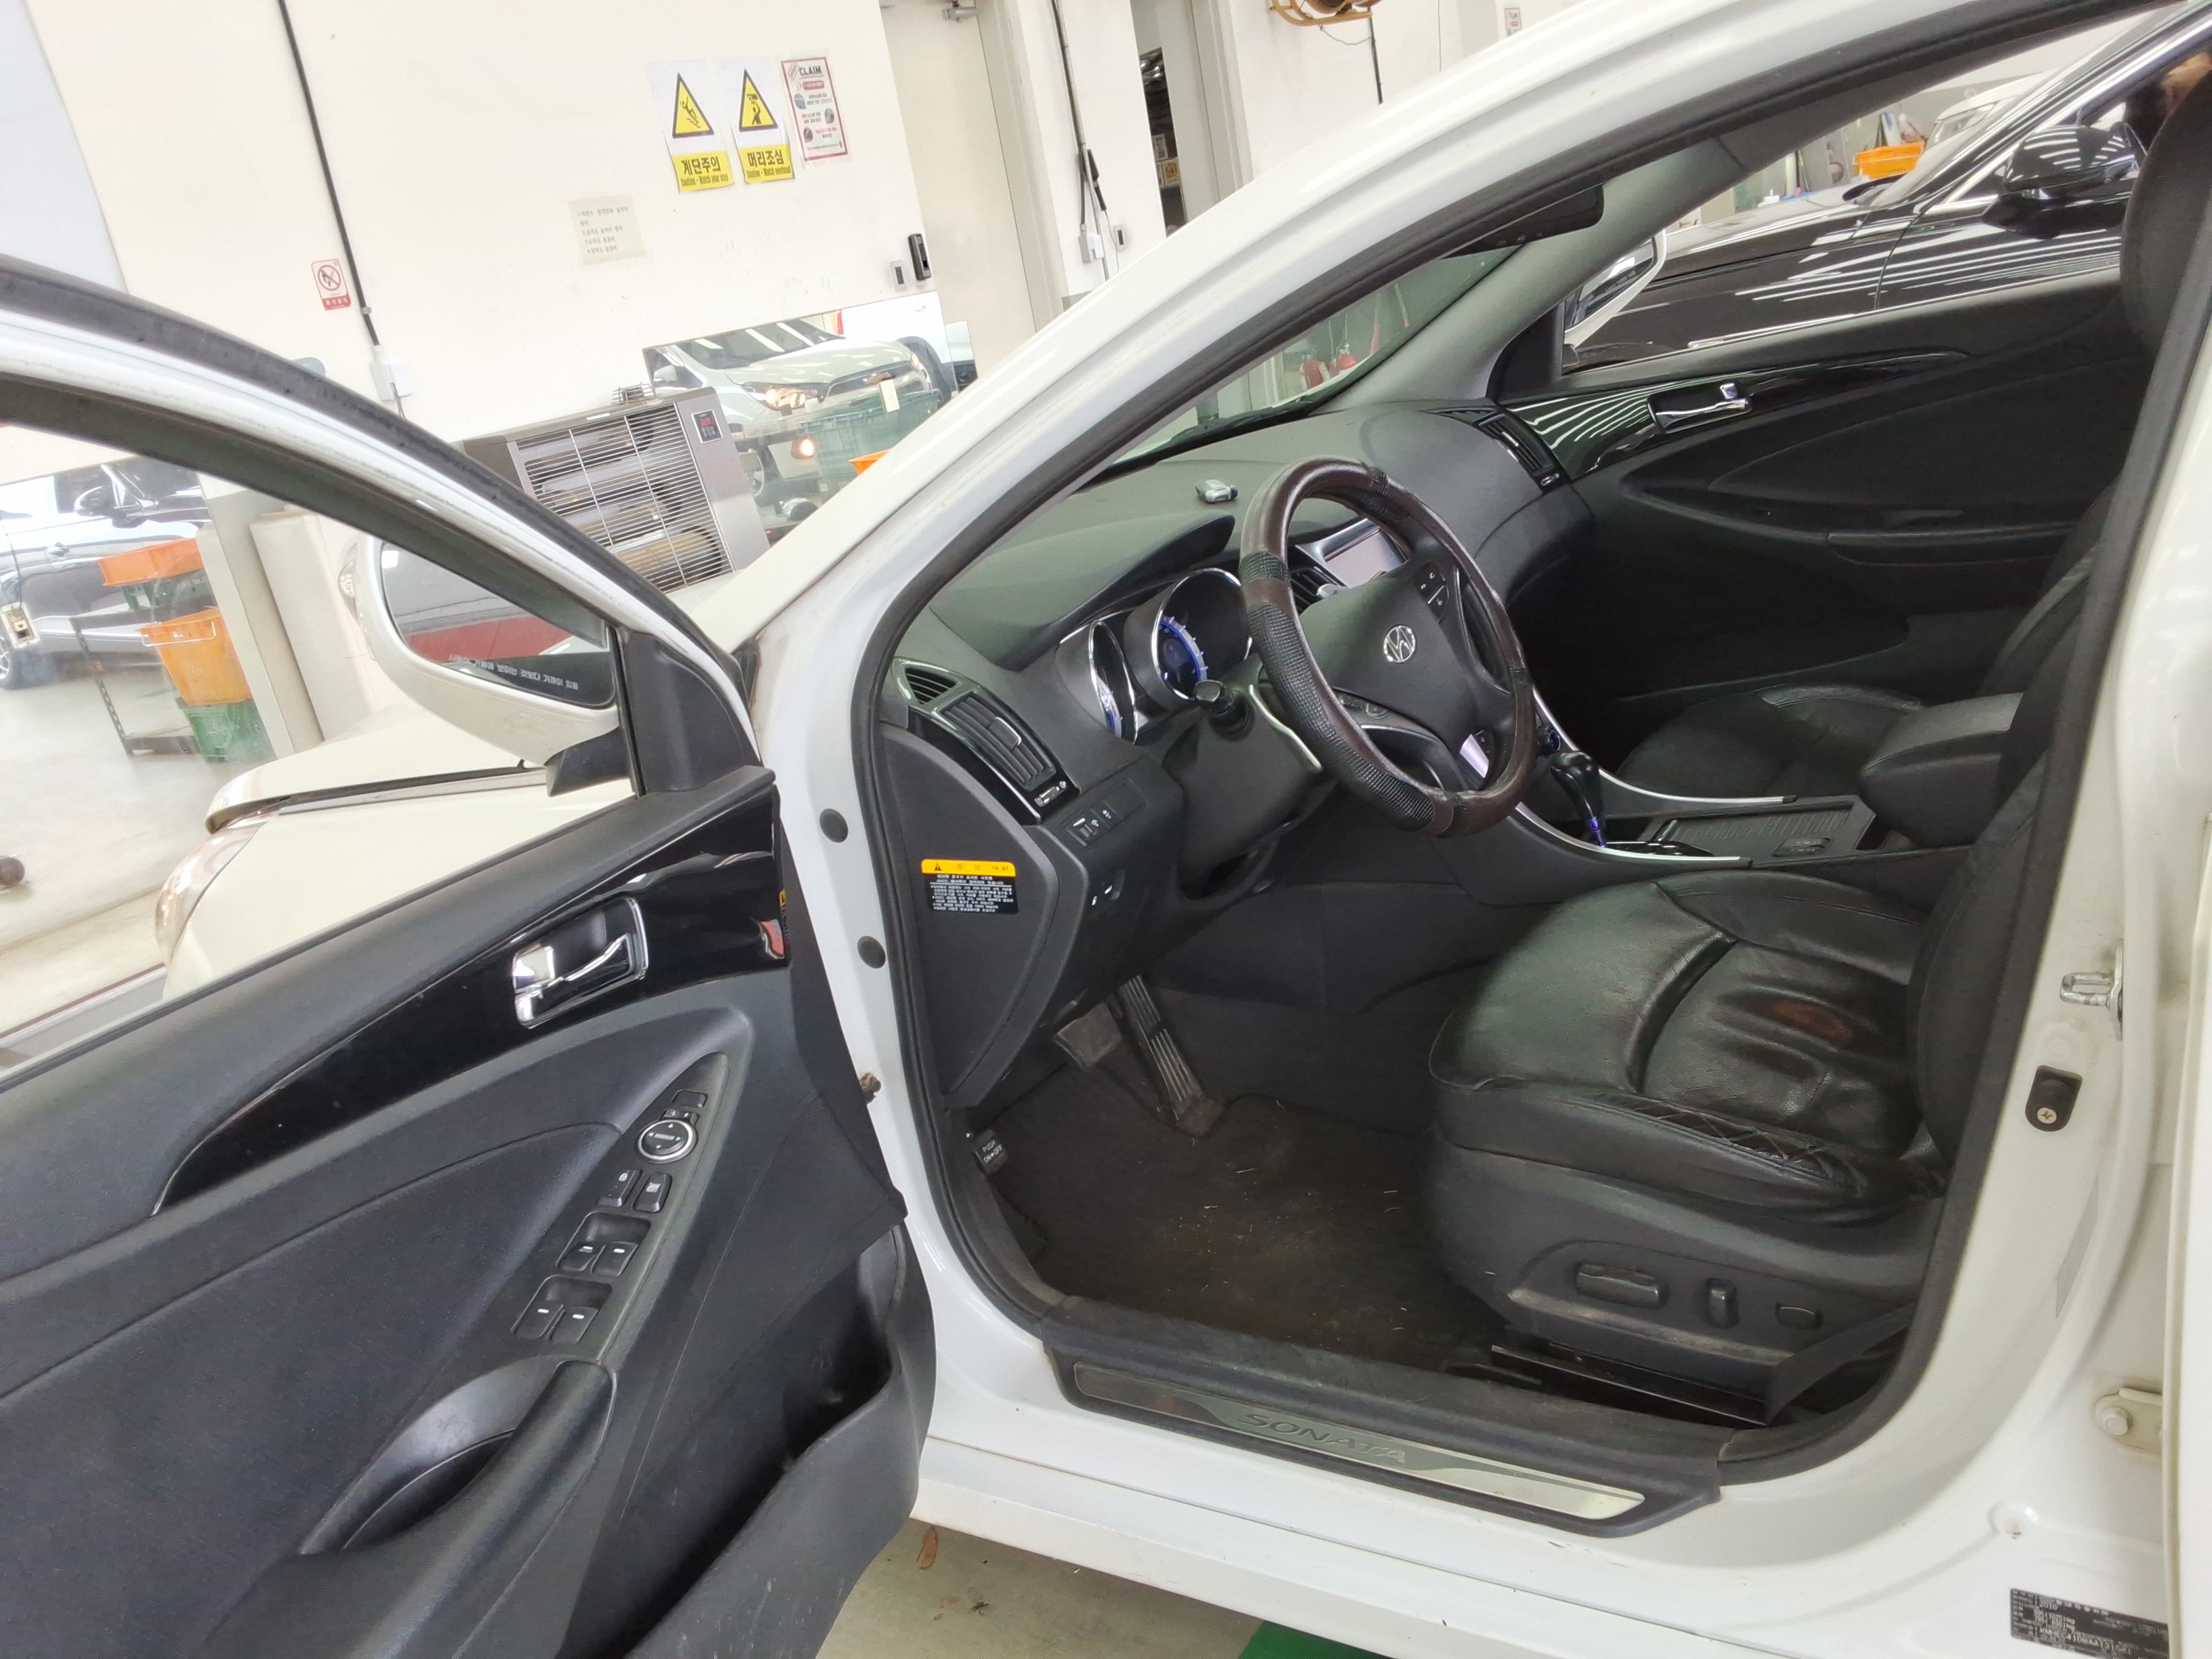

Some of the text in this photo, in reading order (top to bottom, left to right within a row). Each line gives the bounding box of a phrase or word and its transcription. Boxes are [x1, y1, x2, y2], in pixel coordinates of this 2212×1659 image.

[799, 66, 823, 76] CLAIM
[681, 156, 721, 176] 계단주의
[747, 149, 784, 167] 머리조심
[543, 674, 563, 687] 가까이
[1237, 1414, 1406, 1464] SONATA
